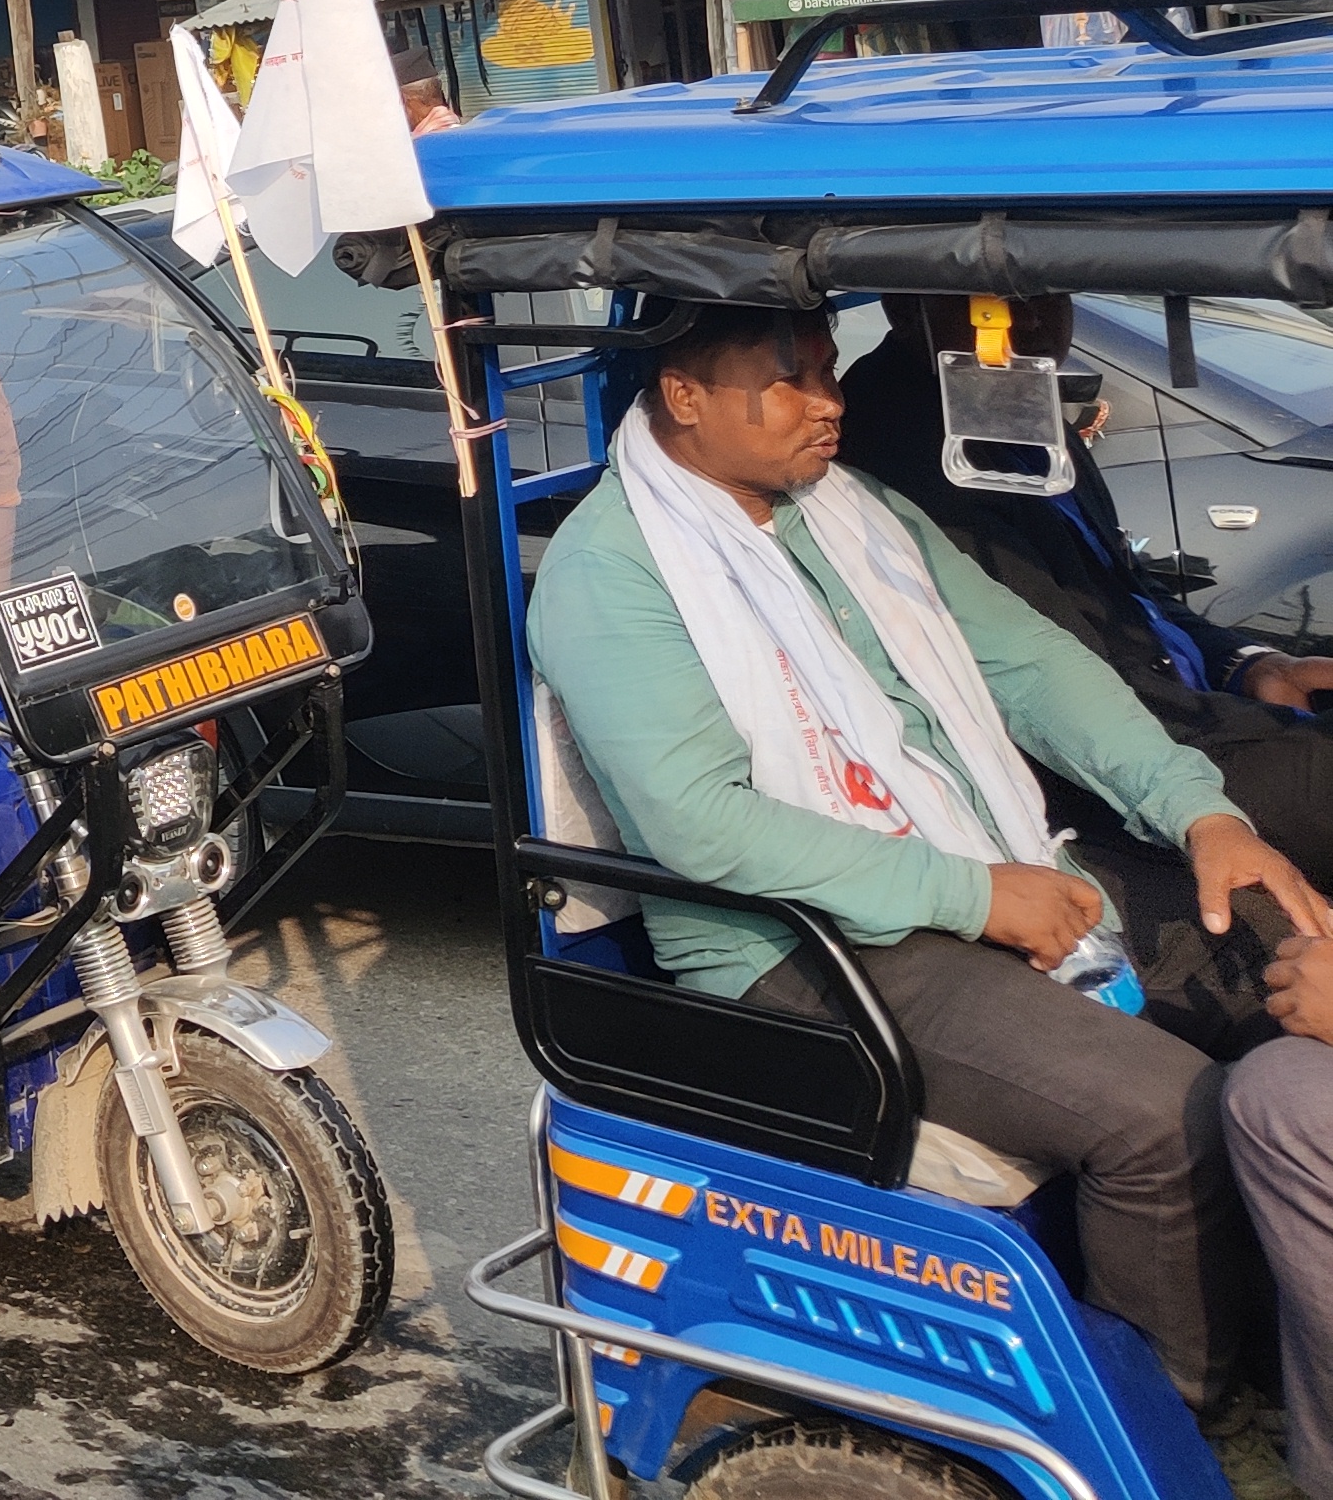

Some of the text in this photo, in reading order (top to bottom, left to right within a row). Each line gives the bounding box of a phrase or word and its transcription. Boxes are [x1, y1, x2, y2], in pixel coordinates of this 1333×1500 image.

[96, 619, 320, 730] PATHIBHARA
[706, 1190, 1012, 1311] EXTA MILEAGE
